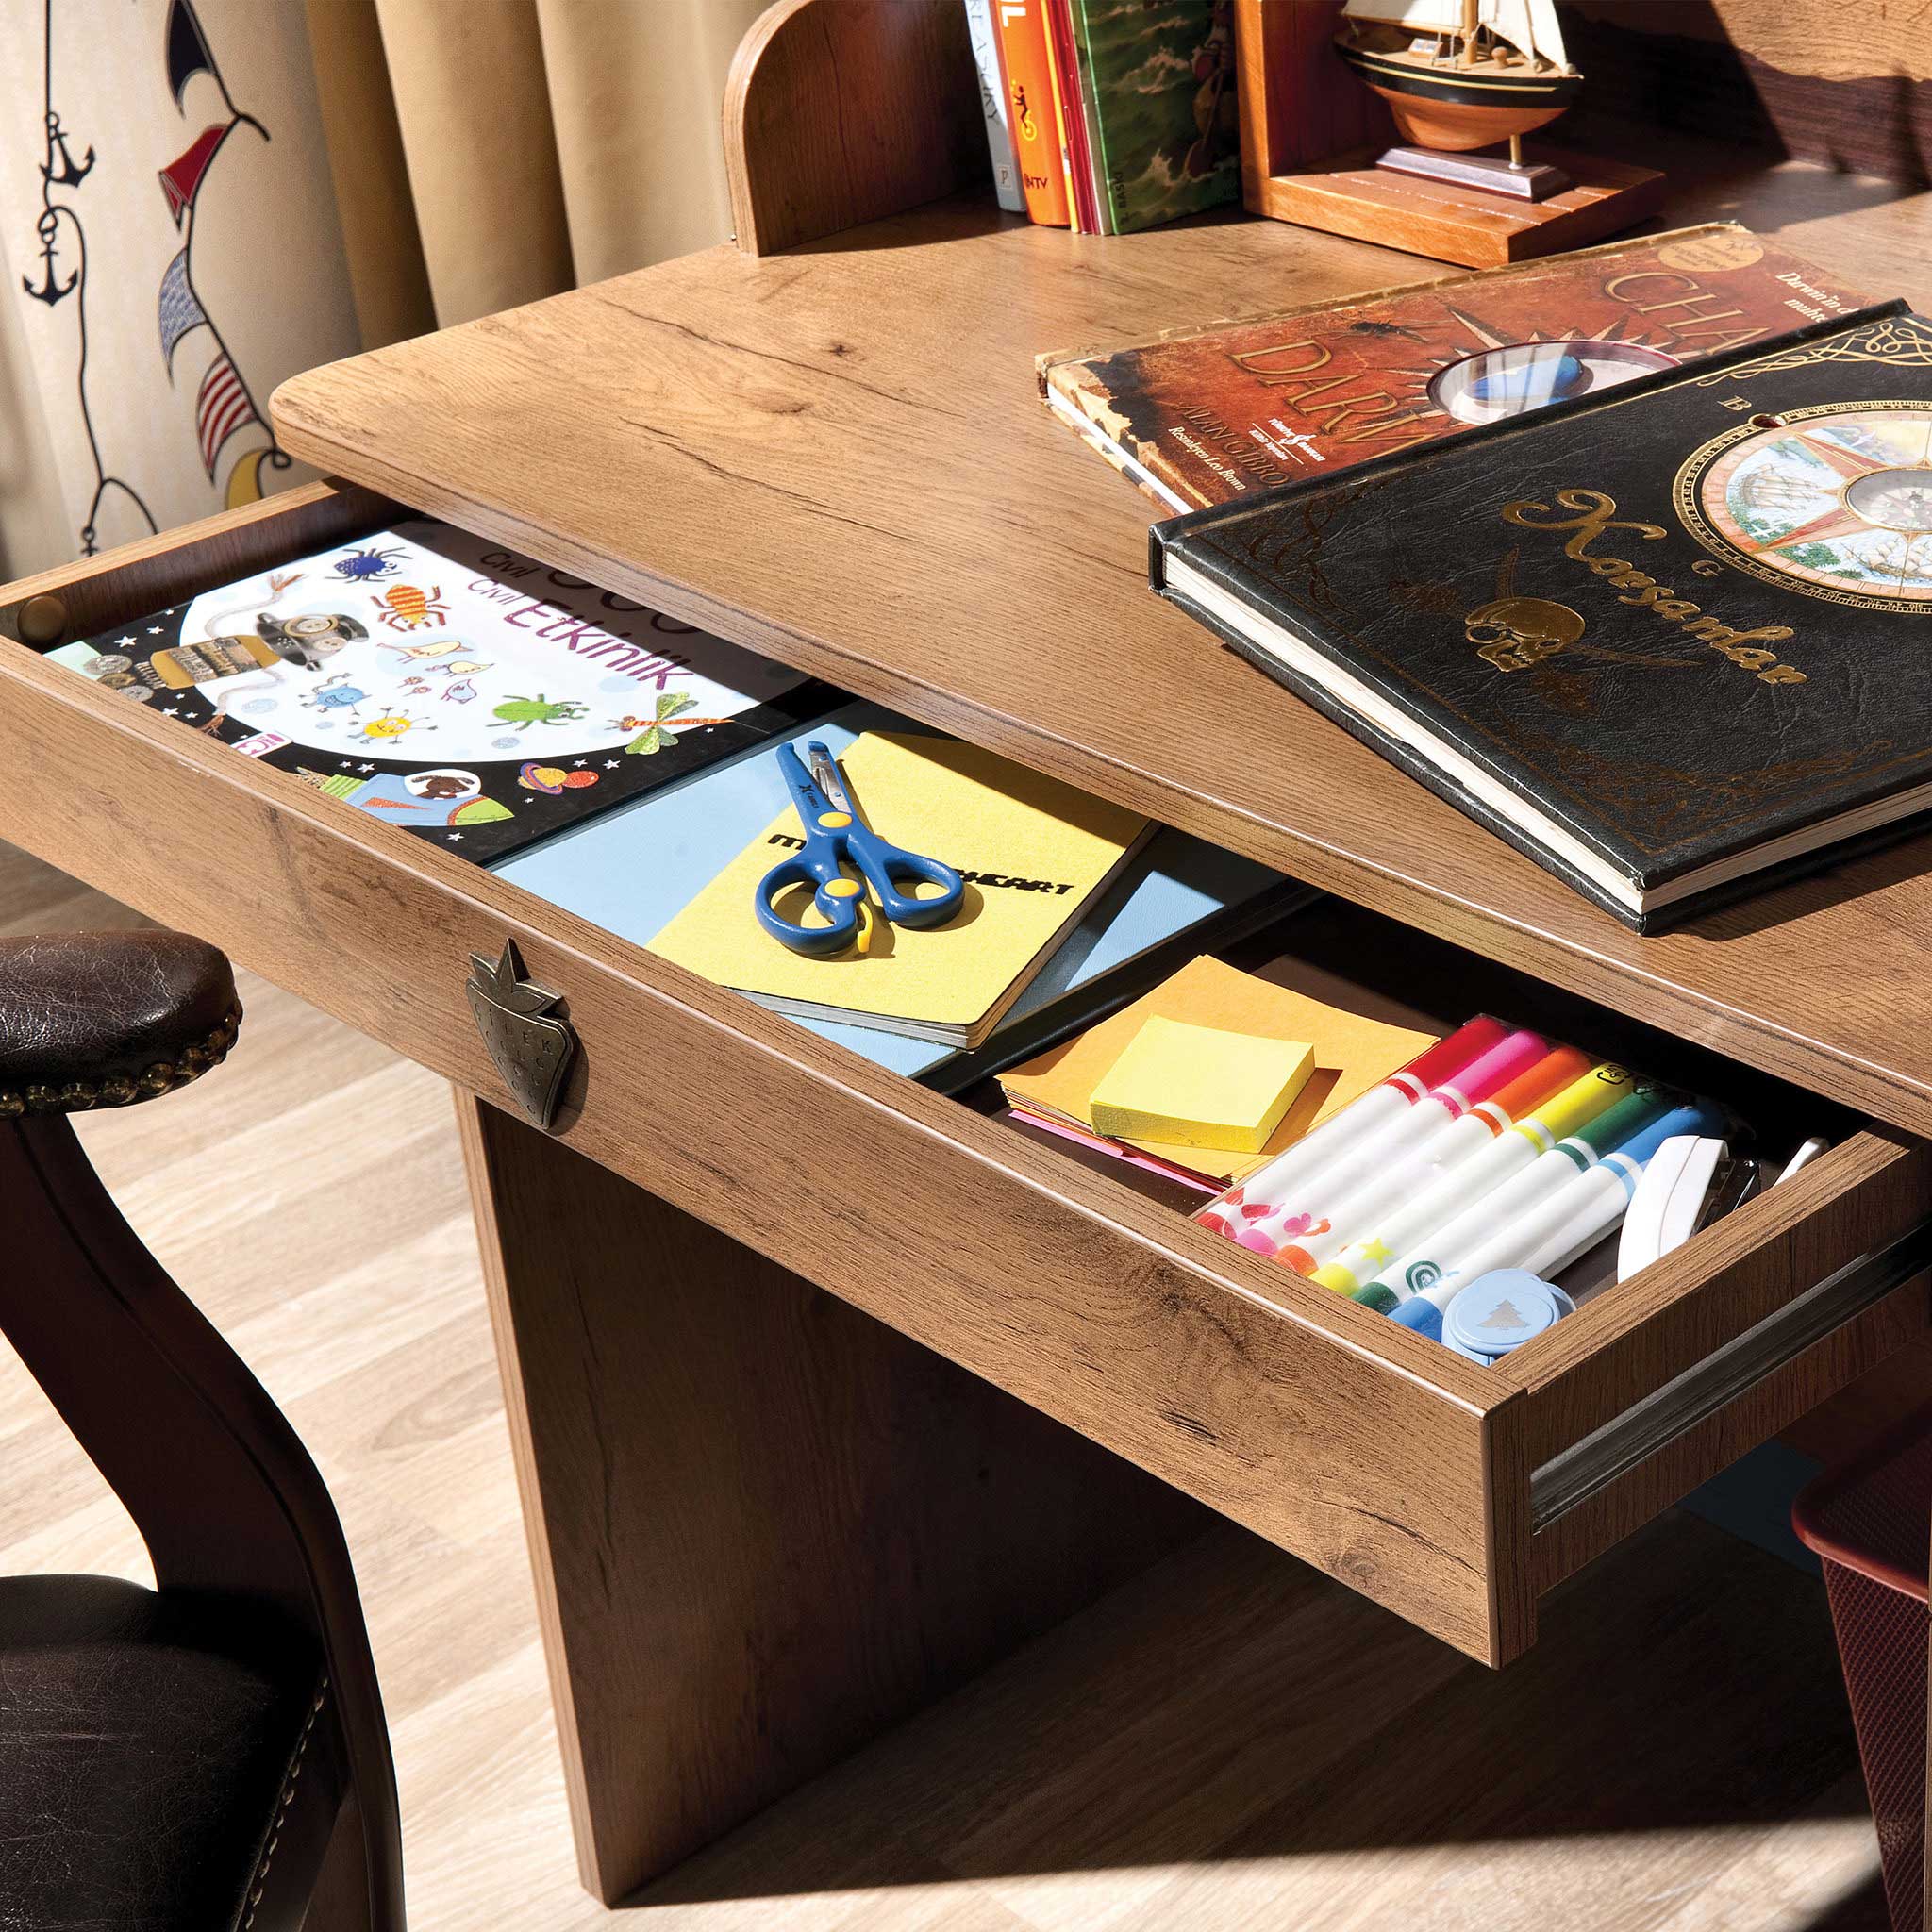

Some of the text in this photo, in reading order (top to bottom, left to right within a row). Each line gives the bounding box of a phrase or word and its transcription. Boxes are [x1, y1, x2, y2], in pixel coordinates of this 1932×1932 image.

[1174, 403, 1290, 489] ALAN GIBBO
[1204, 457, 1223, 471] Leo
[1218, 469, 1246, 491] Brown
[1501, 489, 1808, 685] Korsanlar
